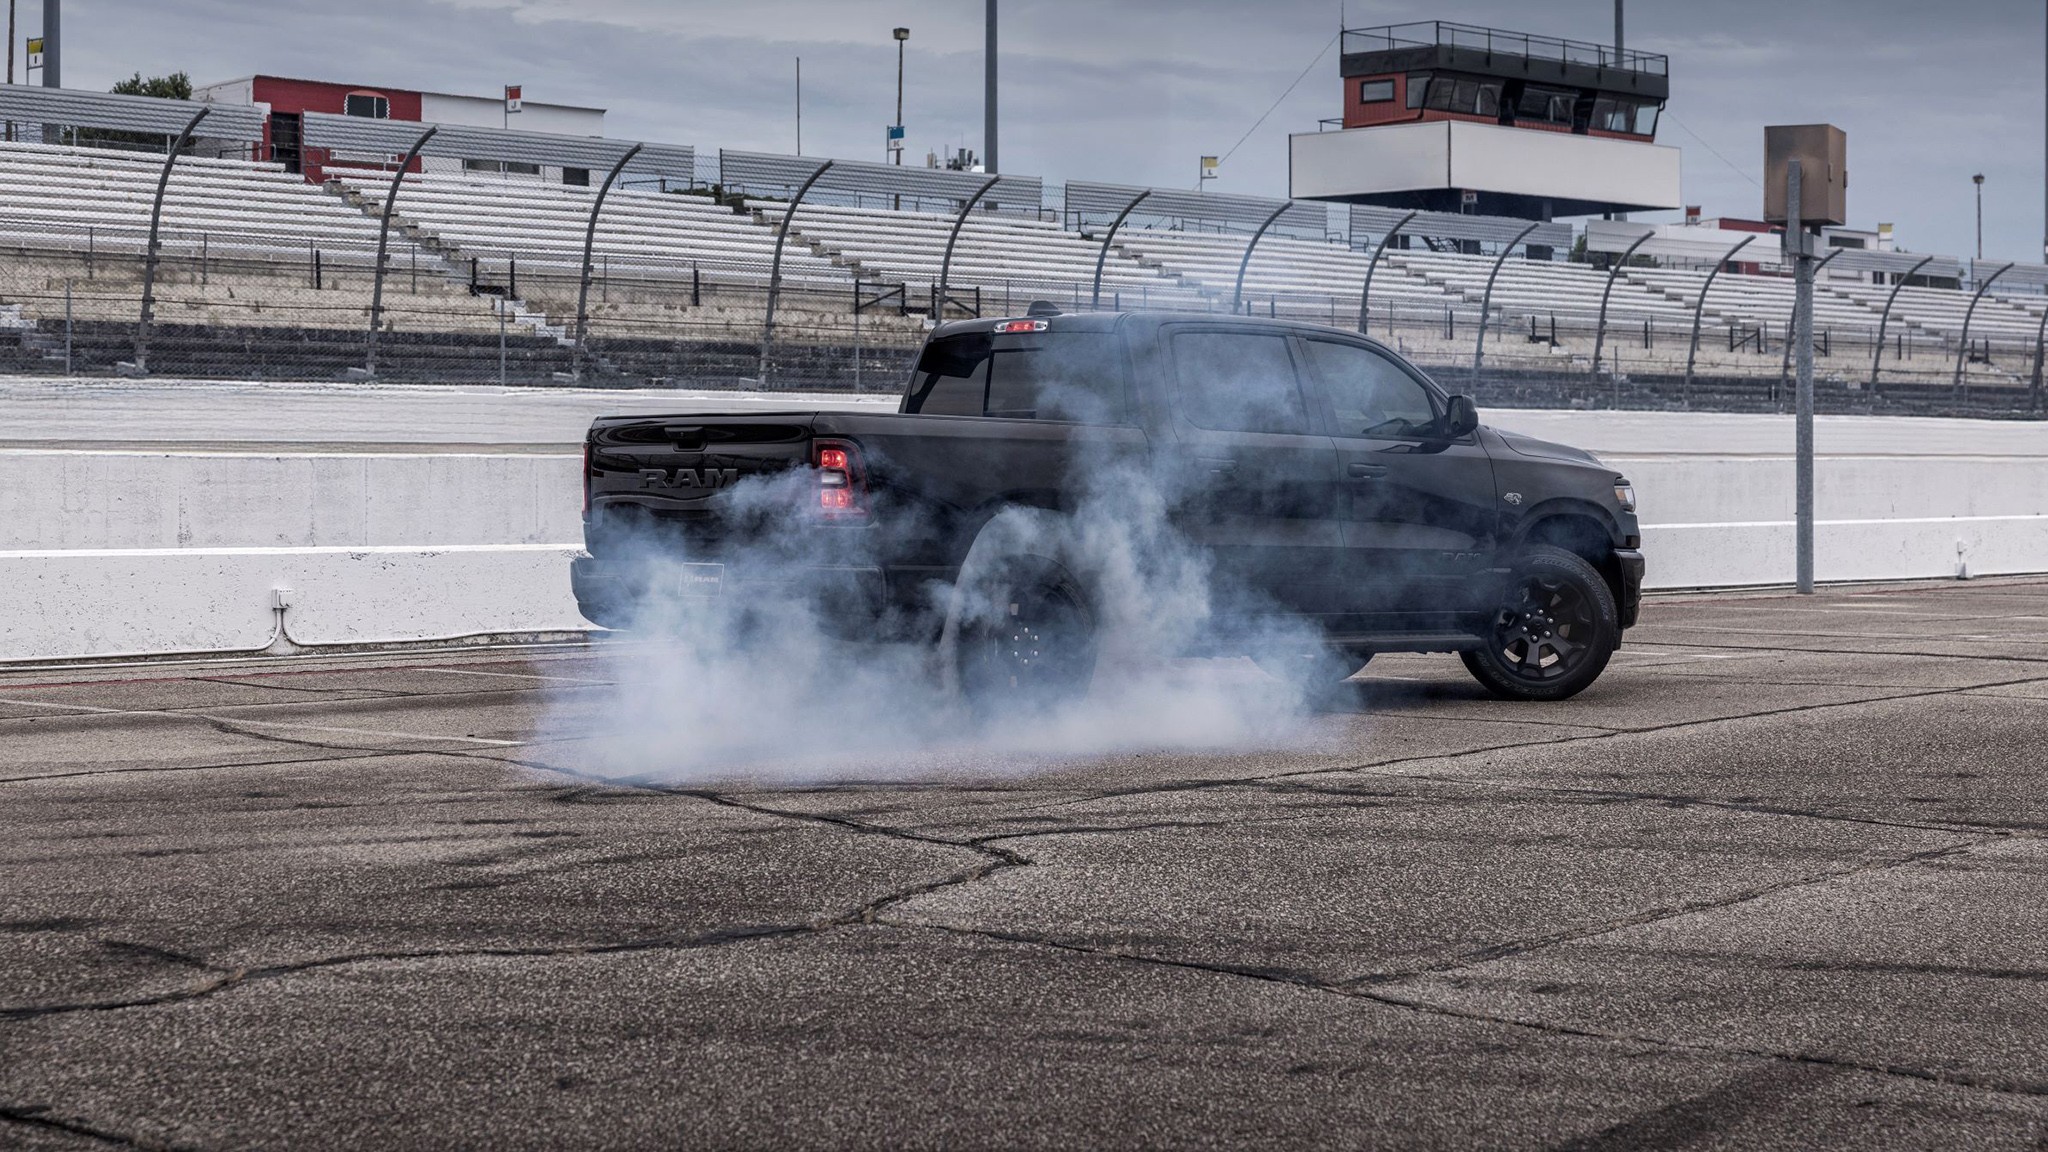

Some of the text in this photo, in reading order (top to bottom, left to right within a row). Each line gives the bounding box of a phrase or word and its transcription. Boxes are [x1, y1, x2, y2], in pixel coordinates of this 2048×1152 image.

[511, 100, 517, 109] J
[893, 140, 900, 148] K
[639, 468, 738, 489] RAM
